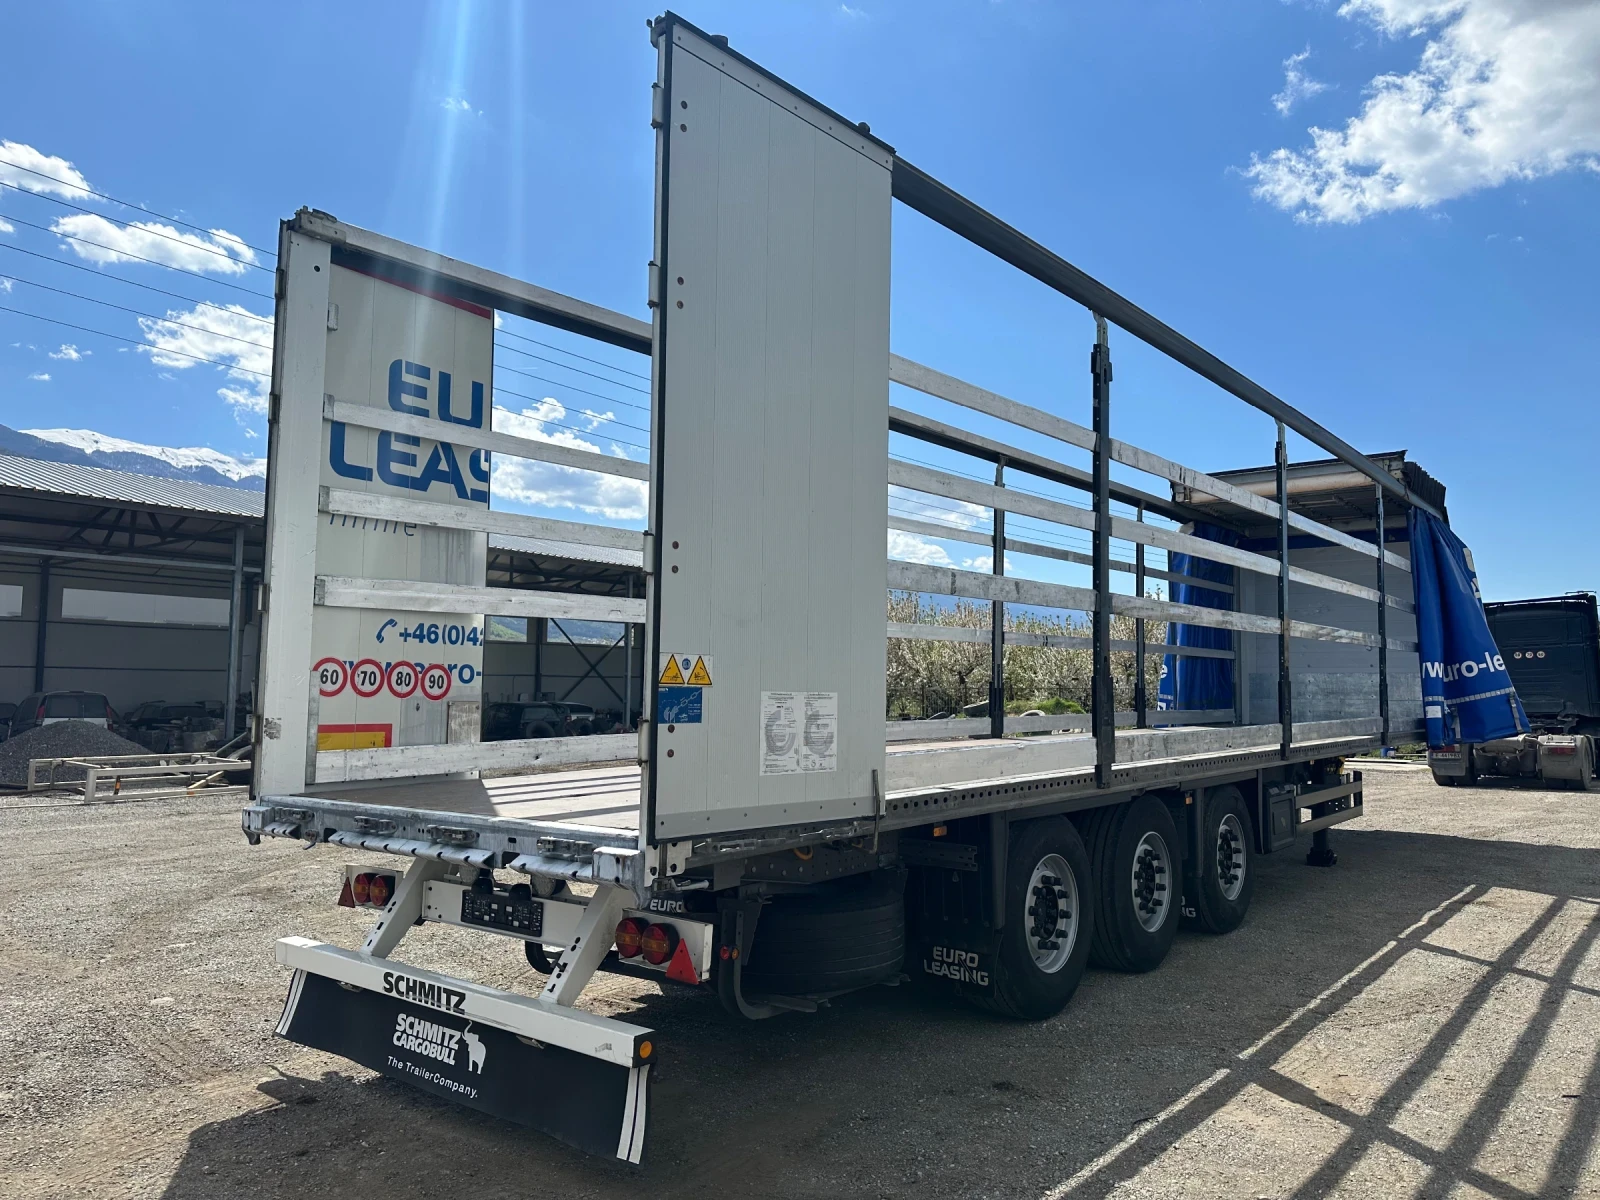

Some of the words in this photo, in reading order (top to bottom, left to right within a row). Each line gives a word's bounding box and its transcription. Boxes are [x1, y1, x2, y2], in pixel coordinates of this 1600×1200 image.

[320, 668, 339, 686] 60
[360, 670, 377, 686] 70
[395, 671, 412, 687] 80
[428, 674, 445, 690] 90
[932, 945, 979, 968] EURO
[923, 958, 989, 986] LEASING
[383, 971, 466, 1015] SCHMITZ
[395, 1013, 462, 1050] SCHMITZ
[387, 1055, 403, 1069] The
[392, 1031, 455, 1066] CARGOBULL
